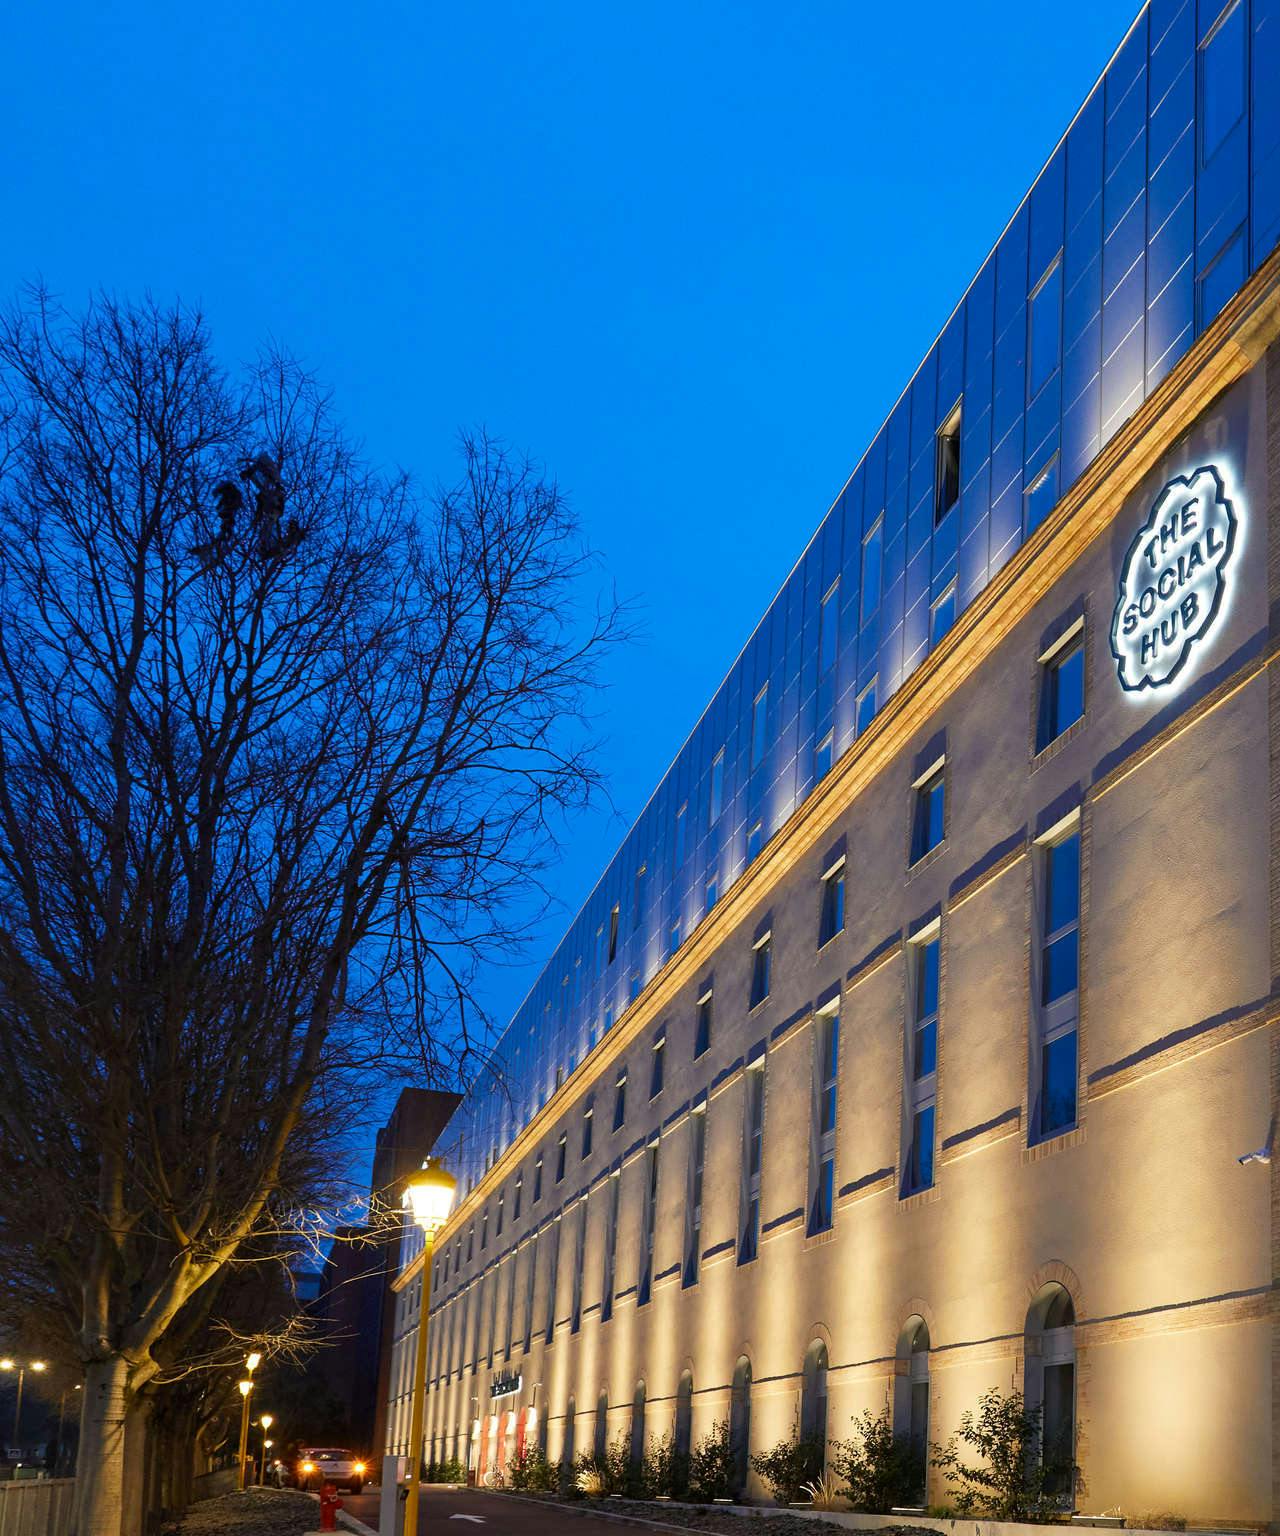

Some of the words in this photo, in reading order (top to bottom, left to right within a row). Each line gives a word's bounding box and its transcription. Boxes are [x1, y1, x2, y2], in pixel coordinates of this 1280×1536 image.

[1144, 497, 1199, 569] THE
[1122, 527, 1224, 635] SOCIAL
[1141, 591, 1200, 665] HUB
